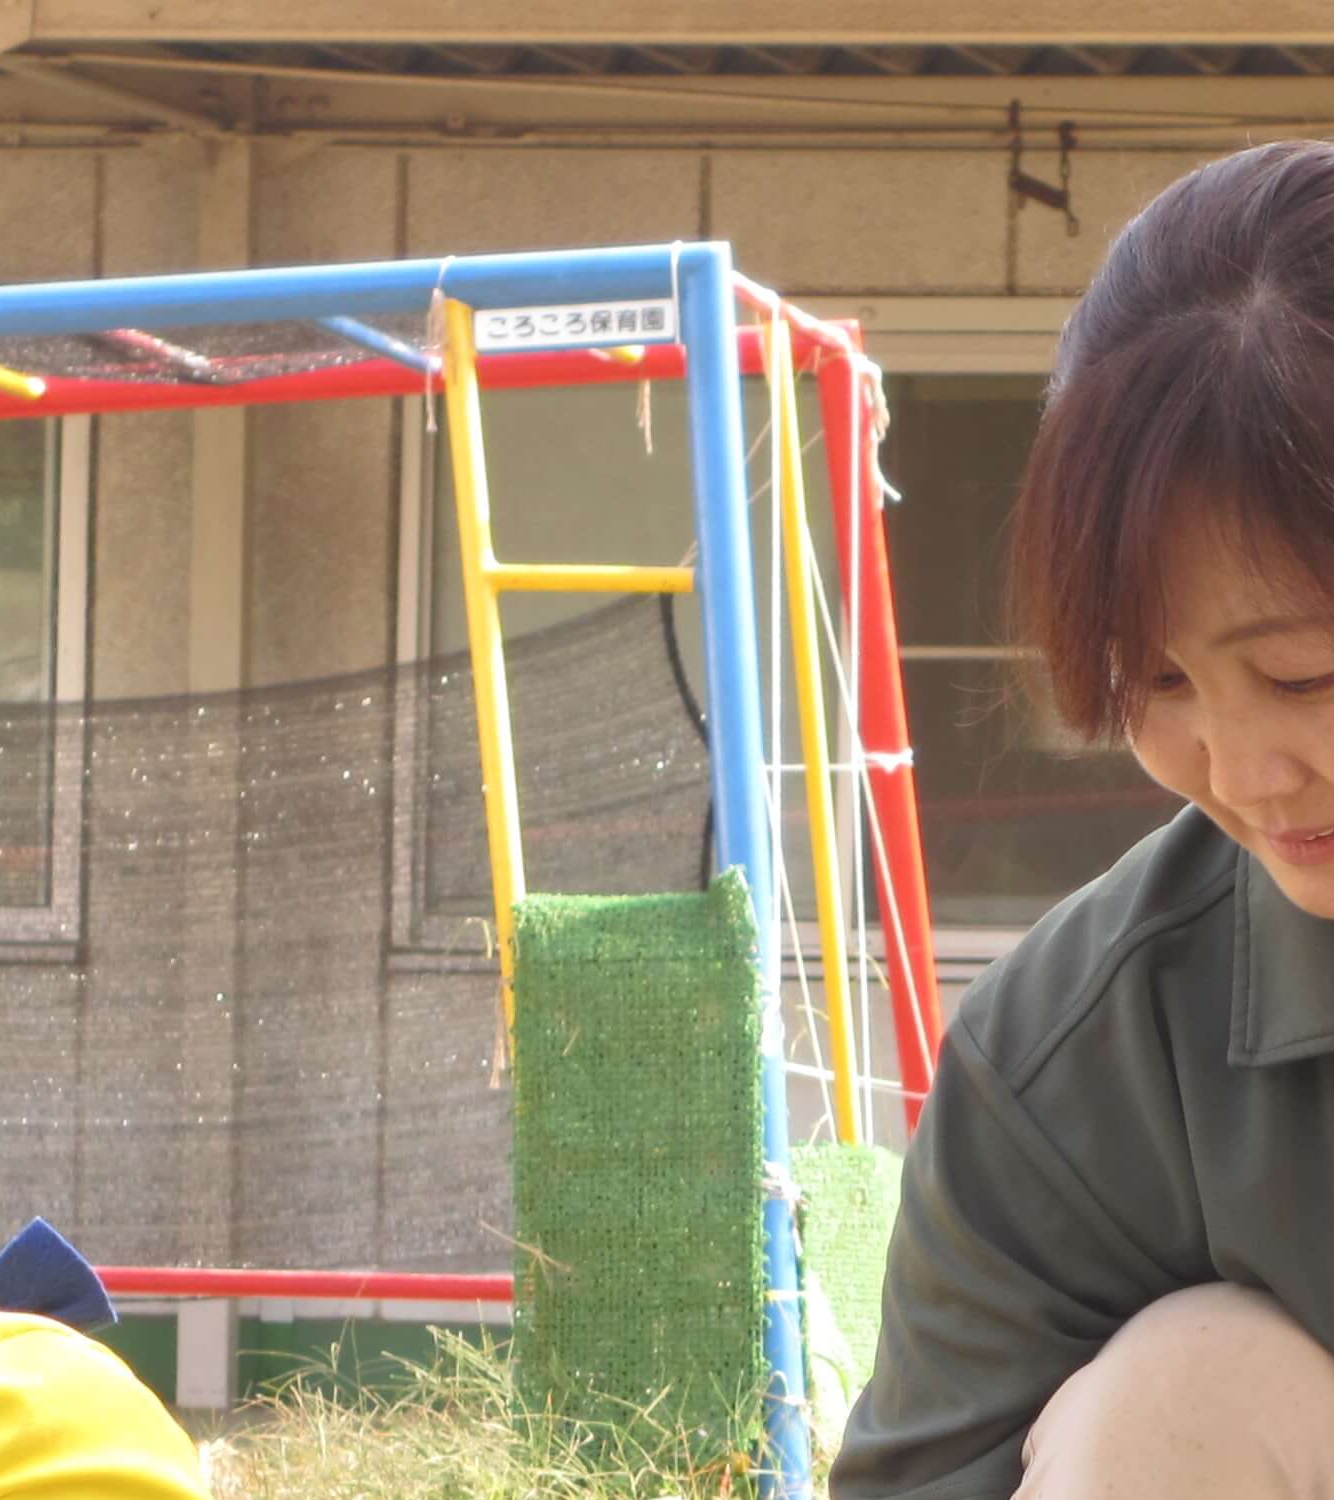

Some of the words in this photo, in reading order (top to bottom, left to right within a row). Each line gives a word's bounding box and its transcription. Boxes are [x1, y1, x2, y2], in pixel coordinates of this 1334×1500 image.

[488, 306, 665, 338] ころころ保育園
